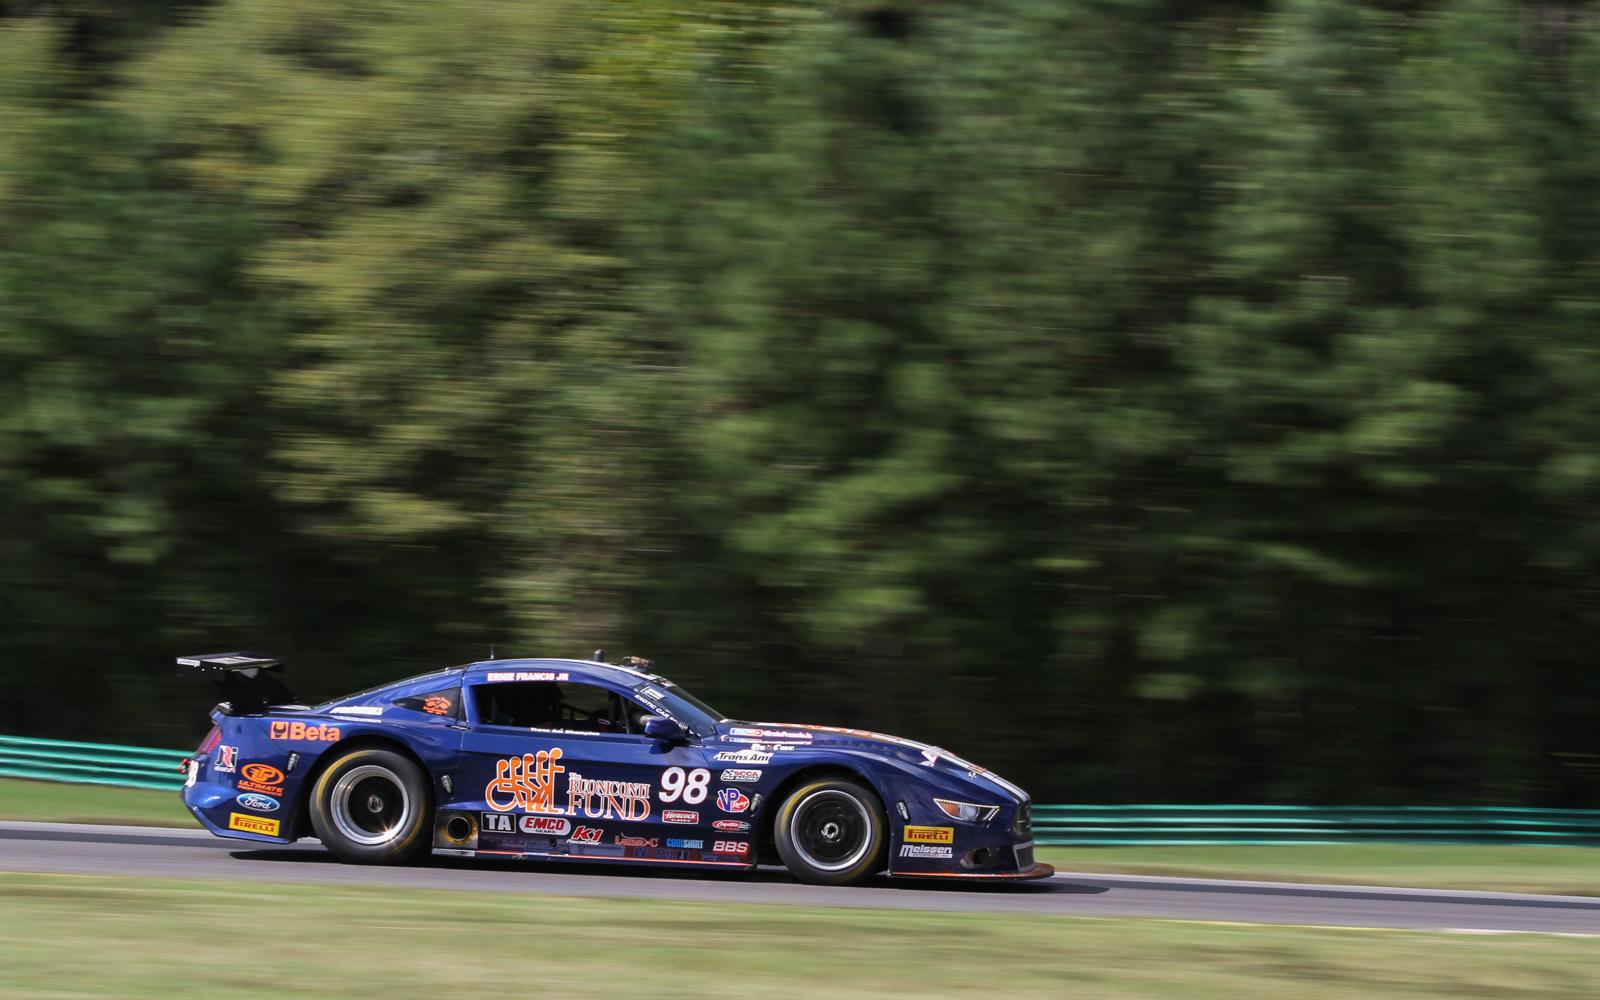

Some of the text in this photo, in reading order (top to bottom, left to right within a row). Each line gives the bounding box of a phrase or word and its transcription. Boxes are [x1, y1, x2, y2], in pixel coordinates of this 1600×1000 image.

[516, 673, 555, 681] FRANCIS
[556, 673, 569, 681] JR
[634, 694, 670, 719] EXOTIC CAR
[290, 721, 340, 742] Beta
[719, 752, 769, 762] Trans Am
[238, 780, 285, 793] ULTIMATE
[658, 766, 711, 805] 98
[244, 795, 271, 810] Ford
[565, 791, 651, 821] FUND
[717, 788, 741, 812] VP
[234, 817, 276, 833] PIRELLI
[486, 814, 512, 831] TA
[525, 817, 566, 830] EMCO
[571, 825, 604, 842] K1
[908, 829, 949, 841] PIRELLI
[712, 840, 749, 854] BBS
